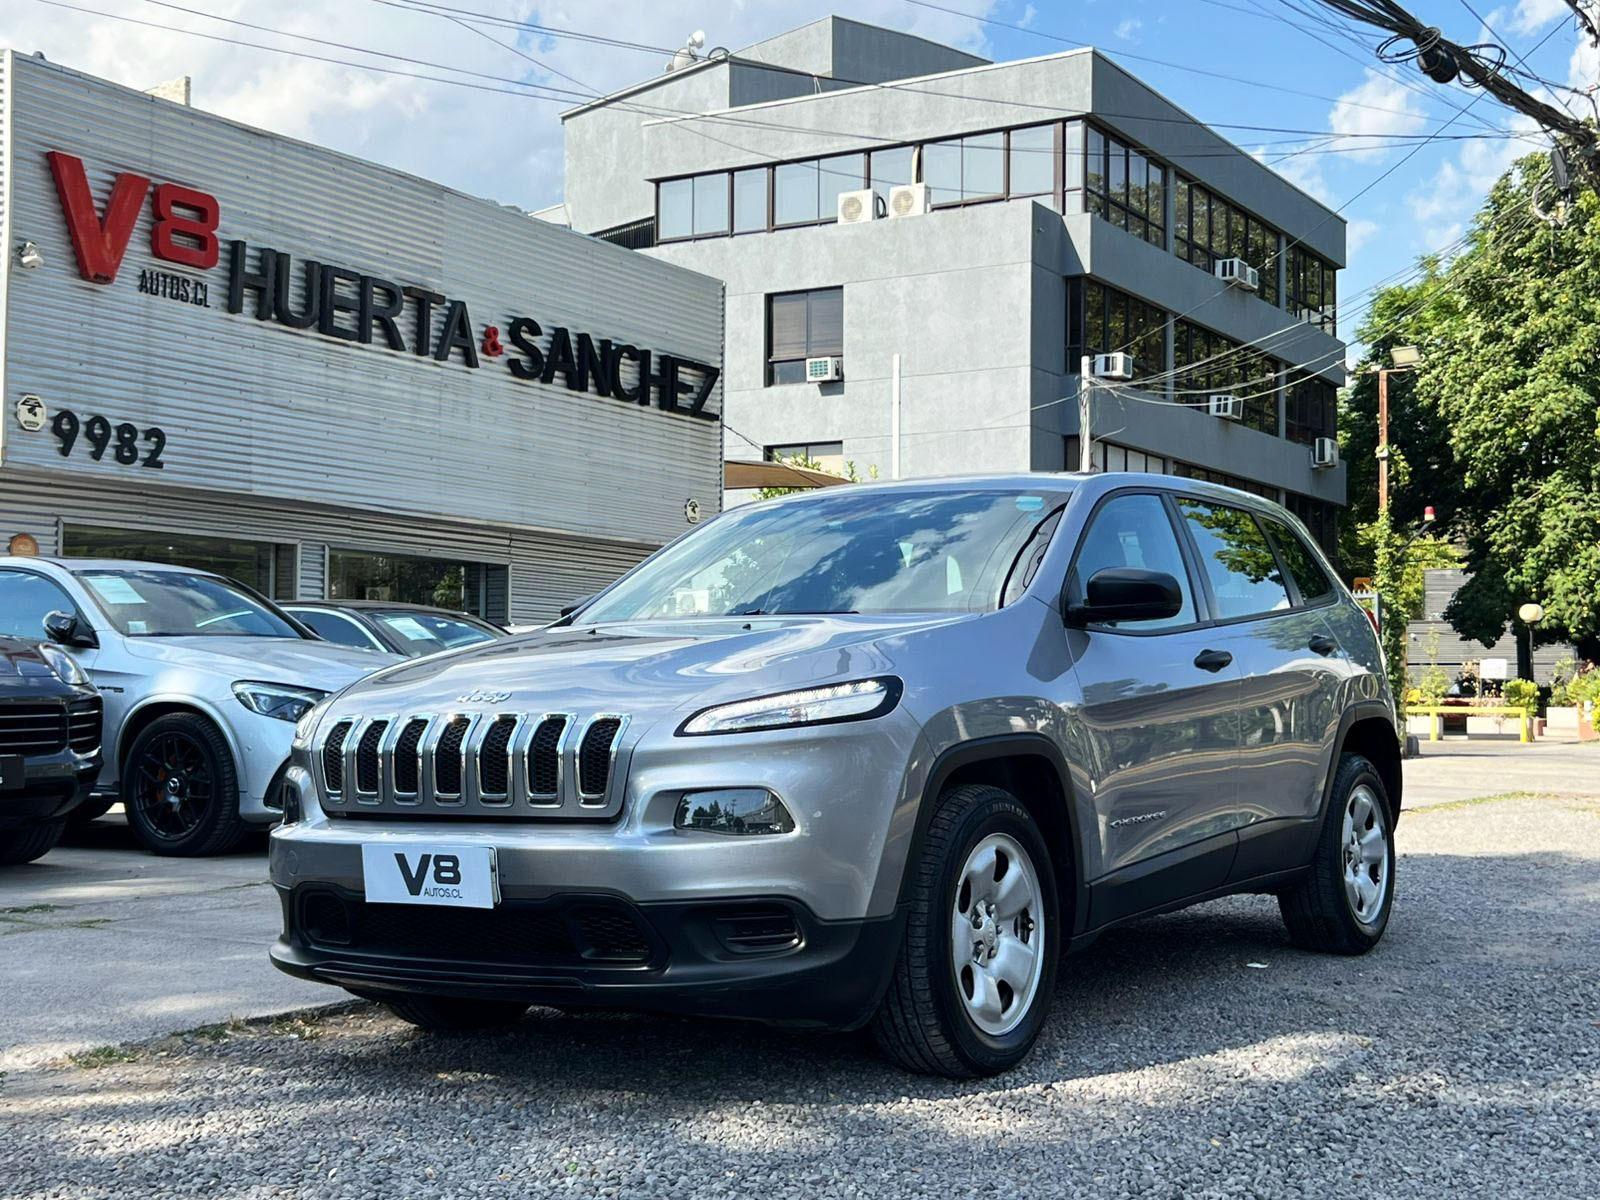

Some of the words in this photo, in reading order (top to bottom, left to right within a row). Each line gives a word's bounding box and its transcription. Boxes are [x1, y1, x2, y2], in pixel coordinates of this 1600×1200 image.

[47, 150, 220, 285] V8
[138, 269, 211, 308] AUTOS.CL
[228, 240, 479, 368] HUERTA
[507, 317, 721, 421] SANCHEZ
[52, 410, 166, 469] 9982
[394, 852, 461, 896] V8
[423, 887, 463, 899] AUTOS.CL
